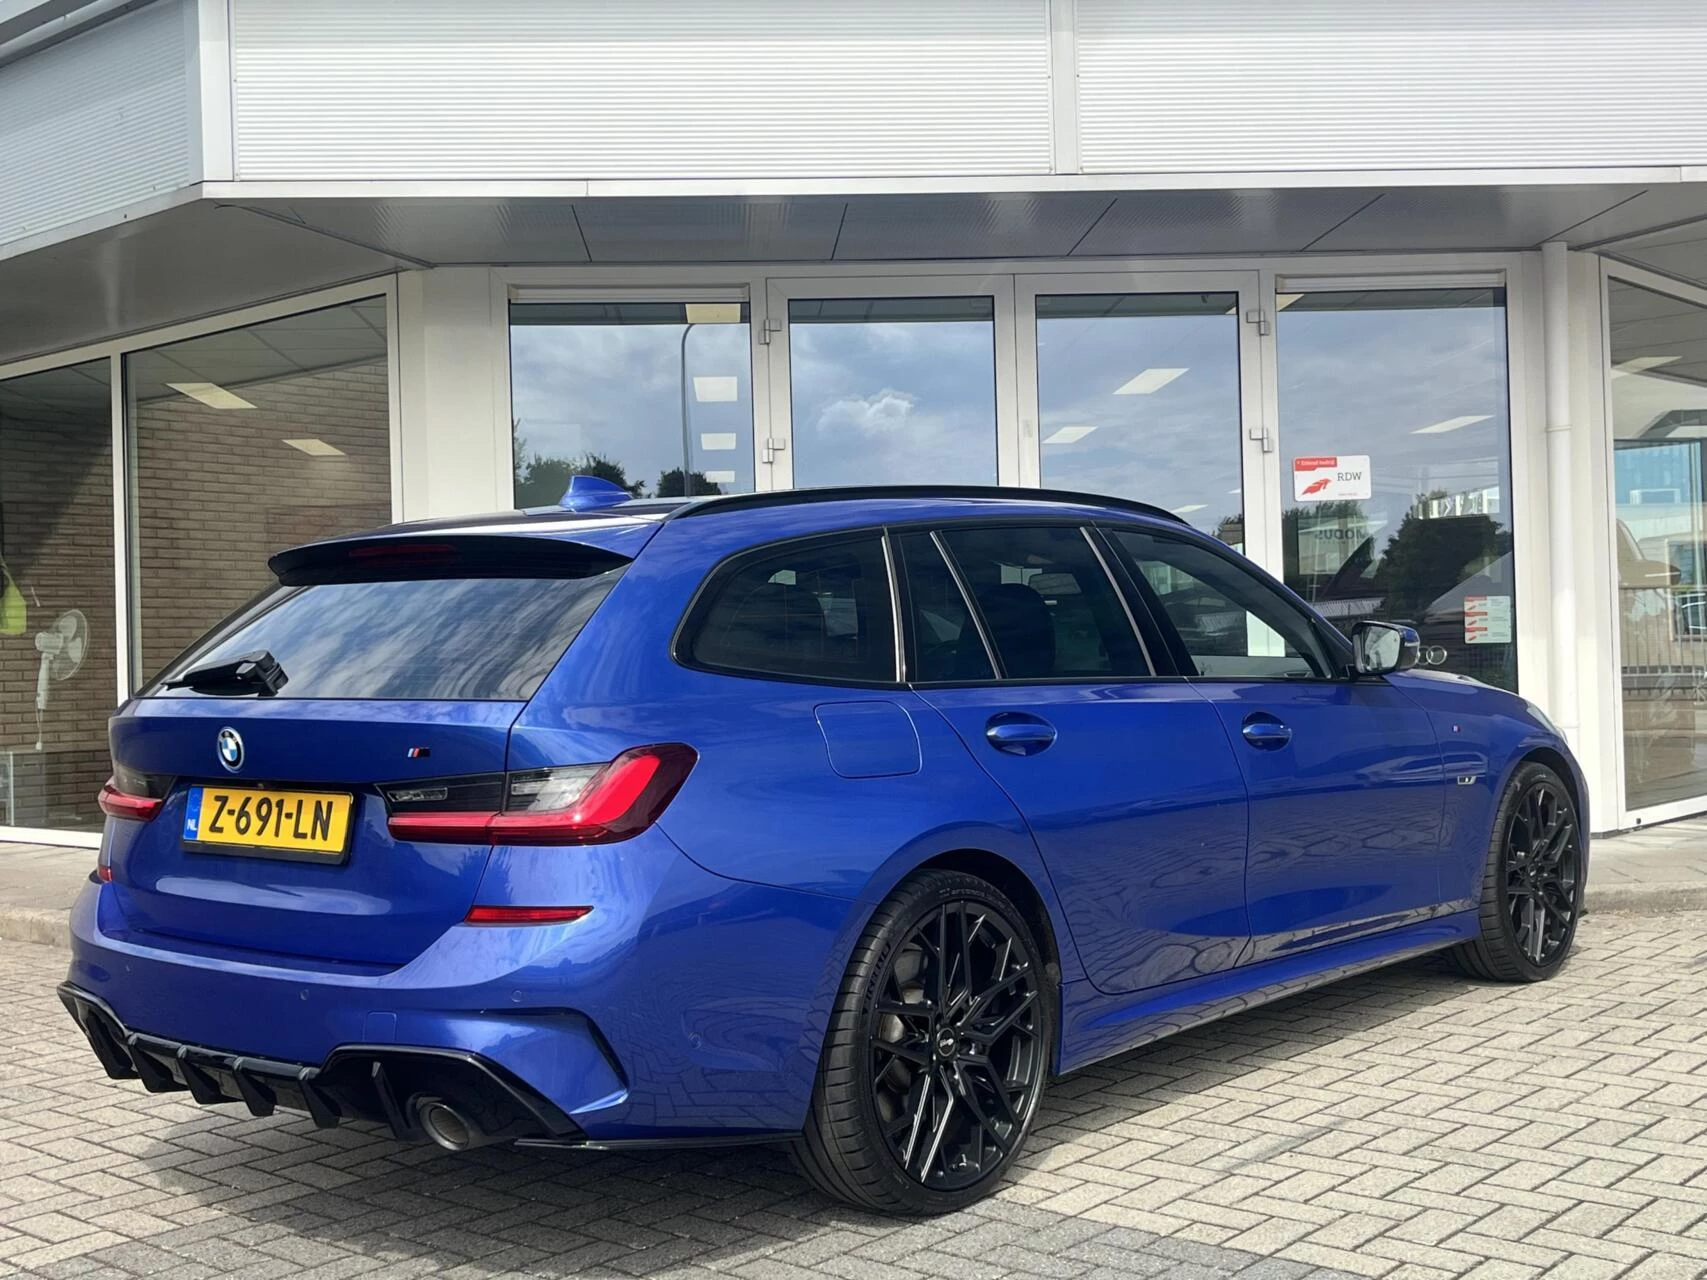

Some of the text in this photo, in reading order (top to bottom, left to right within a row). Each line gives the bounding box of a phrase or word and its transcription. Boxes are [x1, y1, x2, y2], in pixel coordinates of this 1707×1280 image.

[1337, 471, 1362, 481] RDW
[187, 818, 197, 831] NL
[209, 795, 333, 841] Z-691-LN
